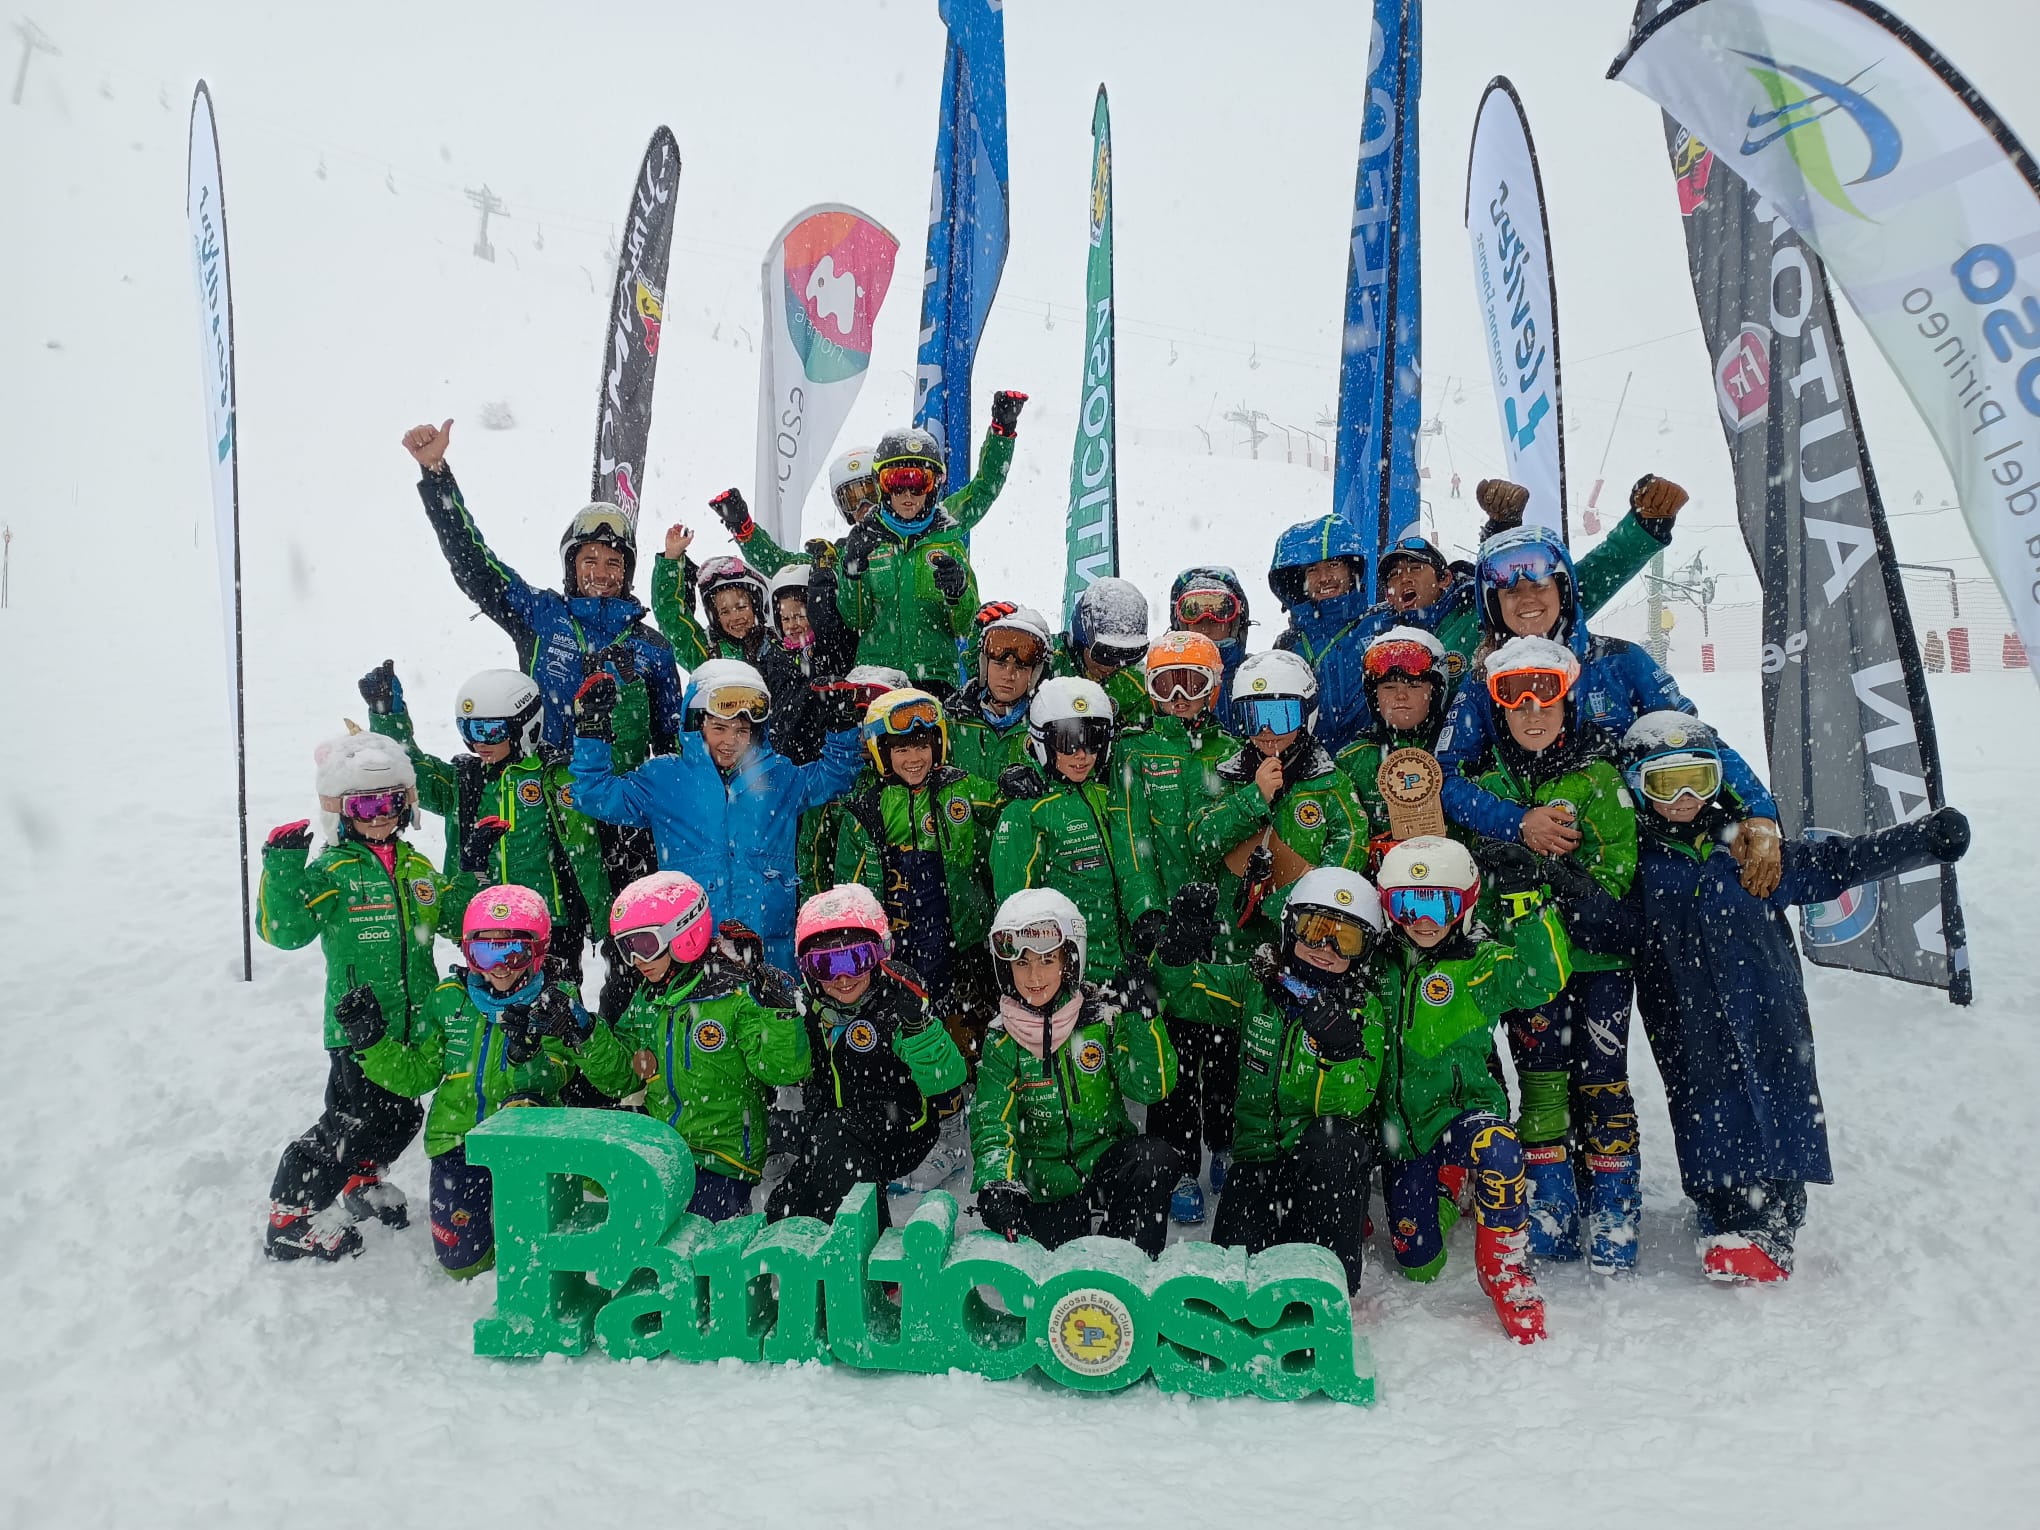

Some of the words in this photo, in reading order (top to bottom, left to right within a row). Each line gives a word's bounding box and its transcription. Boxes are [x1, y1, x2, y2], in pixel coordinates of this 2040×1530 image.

[514, 691, 533, 709] uvex
[1404, 773, 1421, 790] P
[1590, 1159, 1633, 1168] SALOMON
[466, 1107, 1375, 1407] Panticosa
[1049, 1295, 1087, 1334] Panticosa
[1090, 1293, 1120, 1313] Esqui
[1082, 1326, 1105, 1347] P
